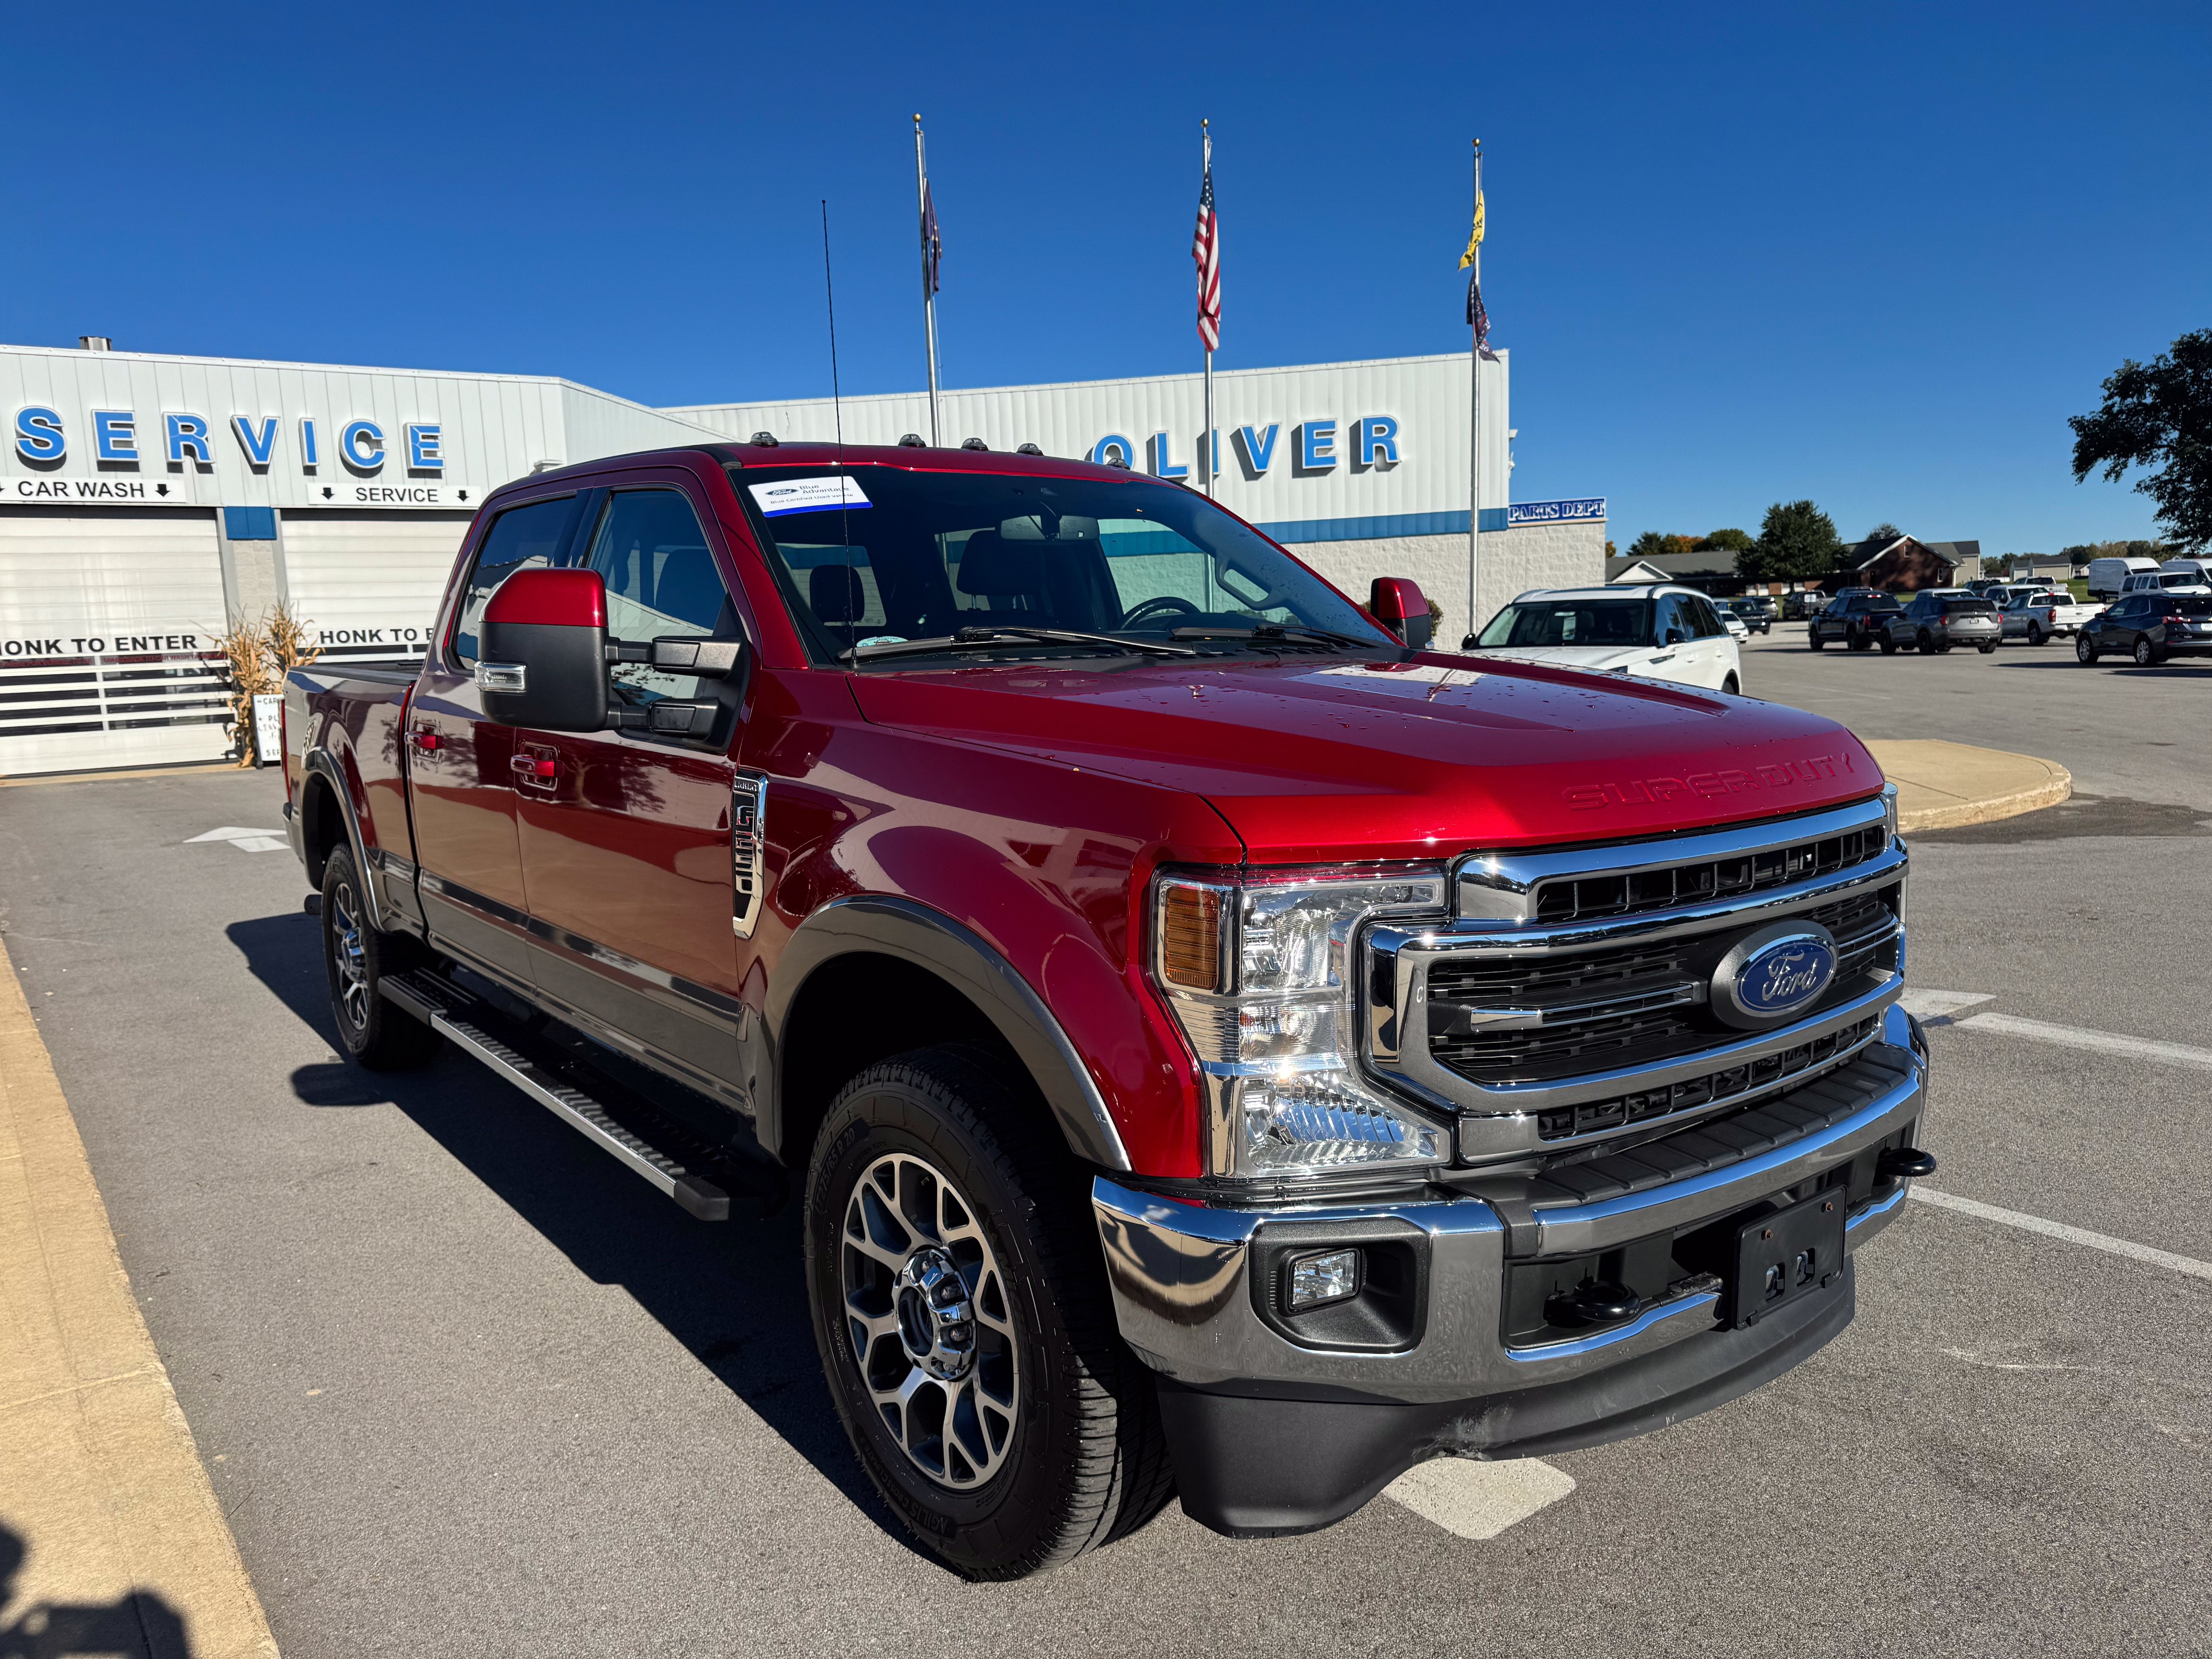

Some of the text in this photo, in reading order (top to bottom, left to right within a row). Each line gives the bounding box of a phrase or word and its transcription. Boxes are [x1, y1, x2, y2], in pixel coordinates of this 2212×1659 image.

[15, 405, 446, 470] SERVICE
[1092, 415, 1401, 479] OLIVER
[18, 481, 144, 498] CAR WASH
[356, 488, 438, 502] SERVICE
[1508, 501, 1605, 521] PARTS DEPT
[0, 635, 198, 656] ONK TO ENTER
[320, 629, 383, 644] HONK
[390, 628, 417, 641] TO
[1561, 752, 1855, 811] SUPER DUTY
[1762, 951, 1818, 1003] Ford
[837, 1141, 845, 1155] R
[844, 1127, 855, 1142] 20
[909, 1501, 949, 1535] AGILIS
